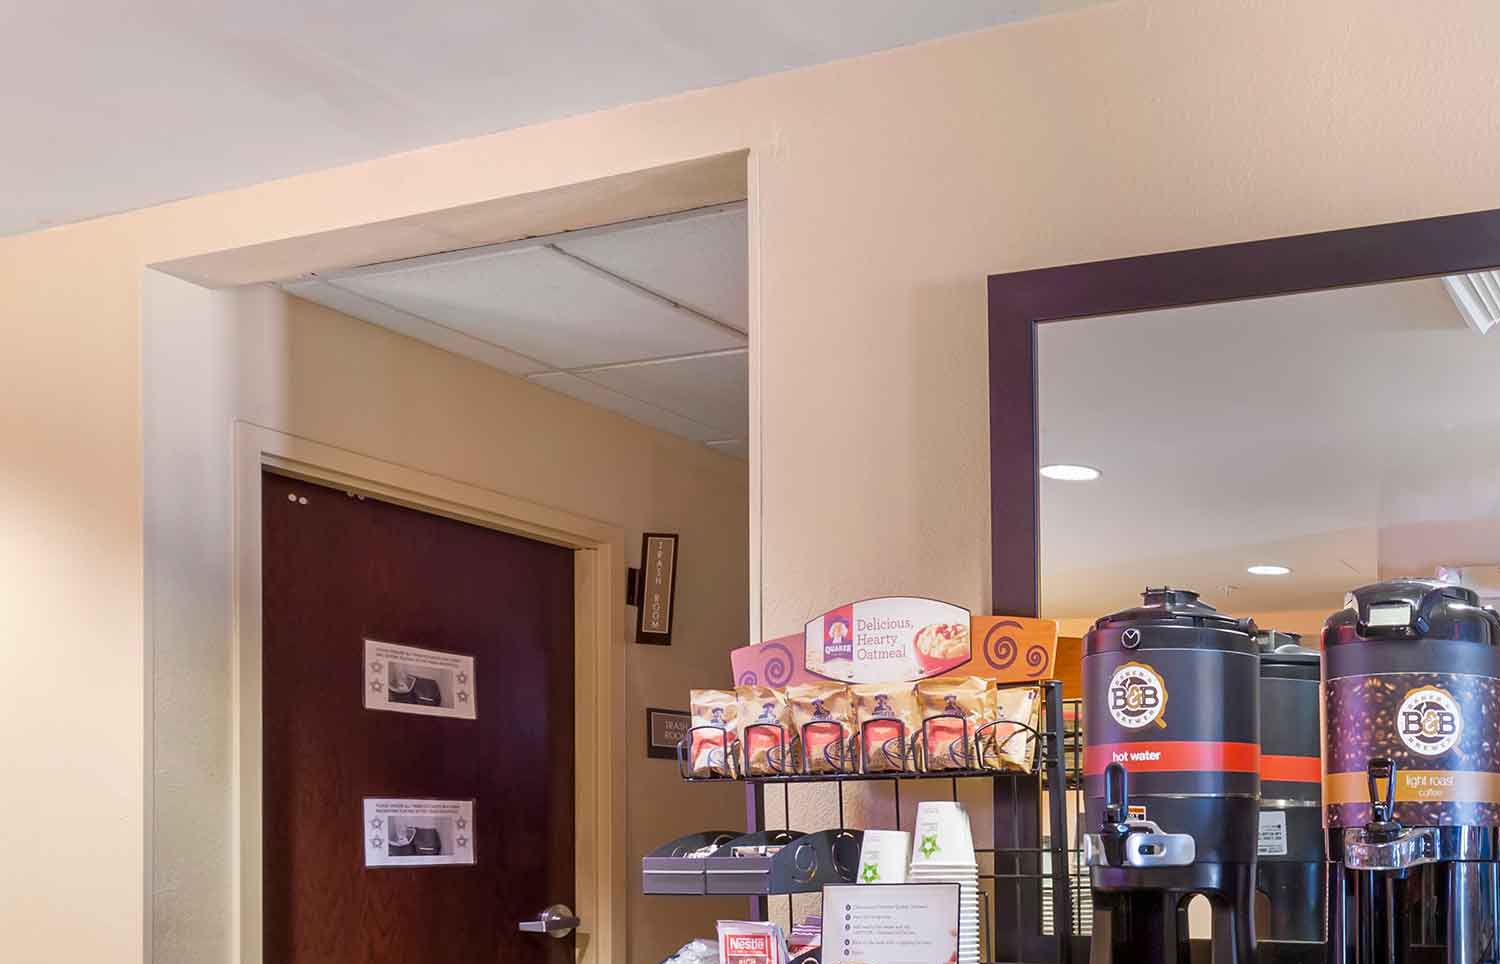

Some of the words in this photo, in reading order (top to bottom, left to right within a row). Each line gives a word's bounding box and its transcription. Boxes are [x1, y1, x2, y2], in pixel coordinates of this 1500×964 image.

[857, 616, 914, 632] Delicious,
[857, 633, 899, 647] Hearty
[856, 645, 907, 661] Oatmeal
[1111, 685, 1160, 710] B&B
[1402, 710, 1457, 735] B&B
[1112, 751, 1128, 762] hot
[1130, 749, 1161, 761] water
[1429, 775, 1456, 786] roast
